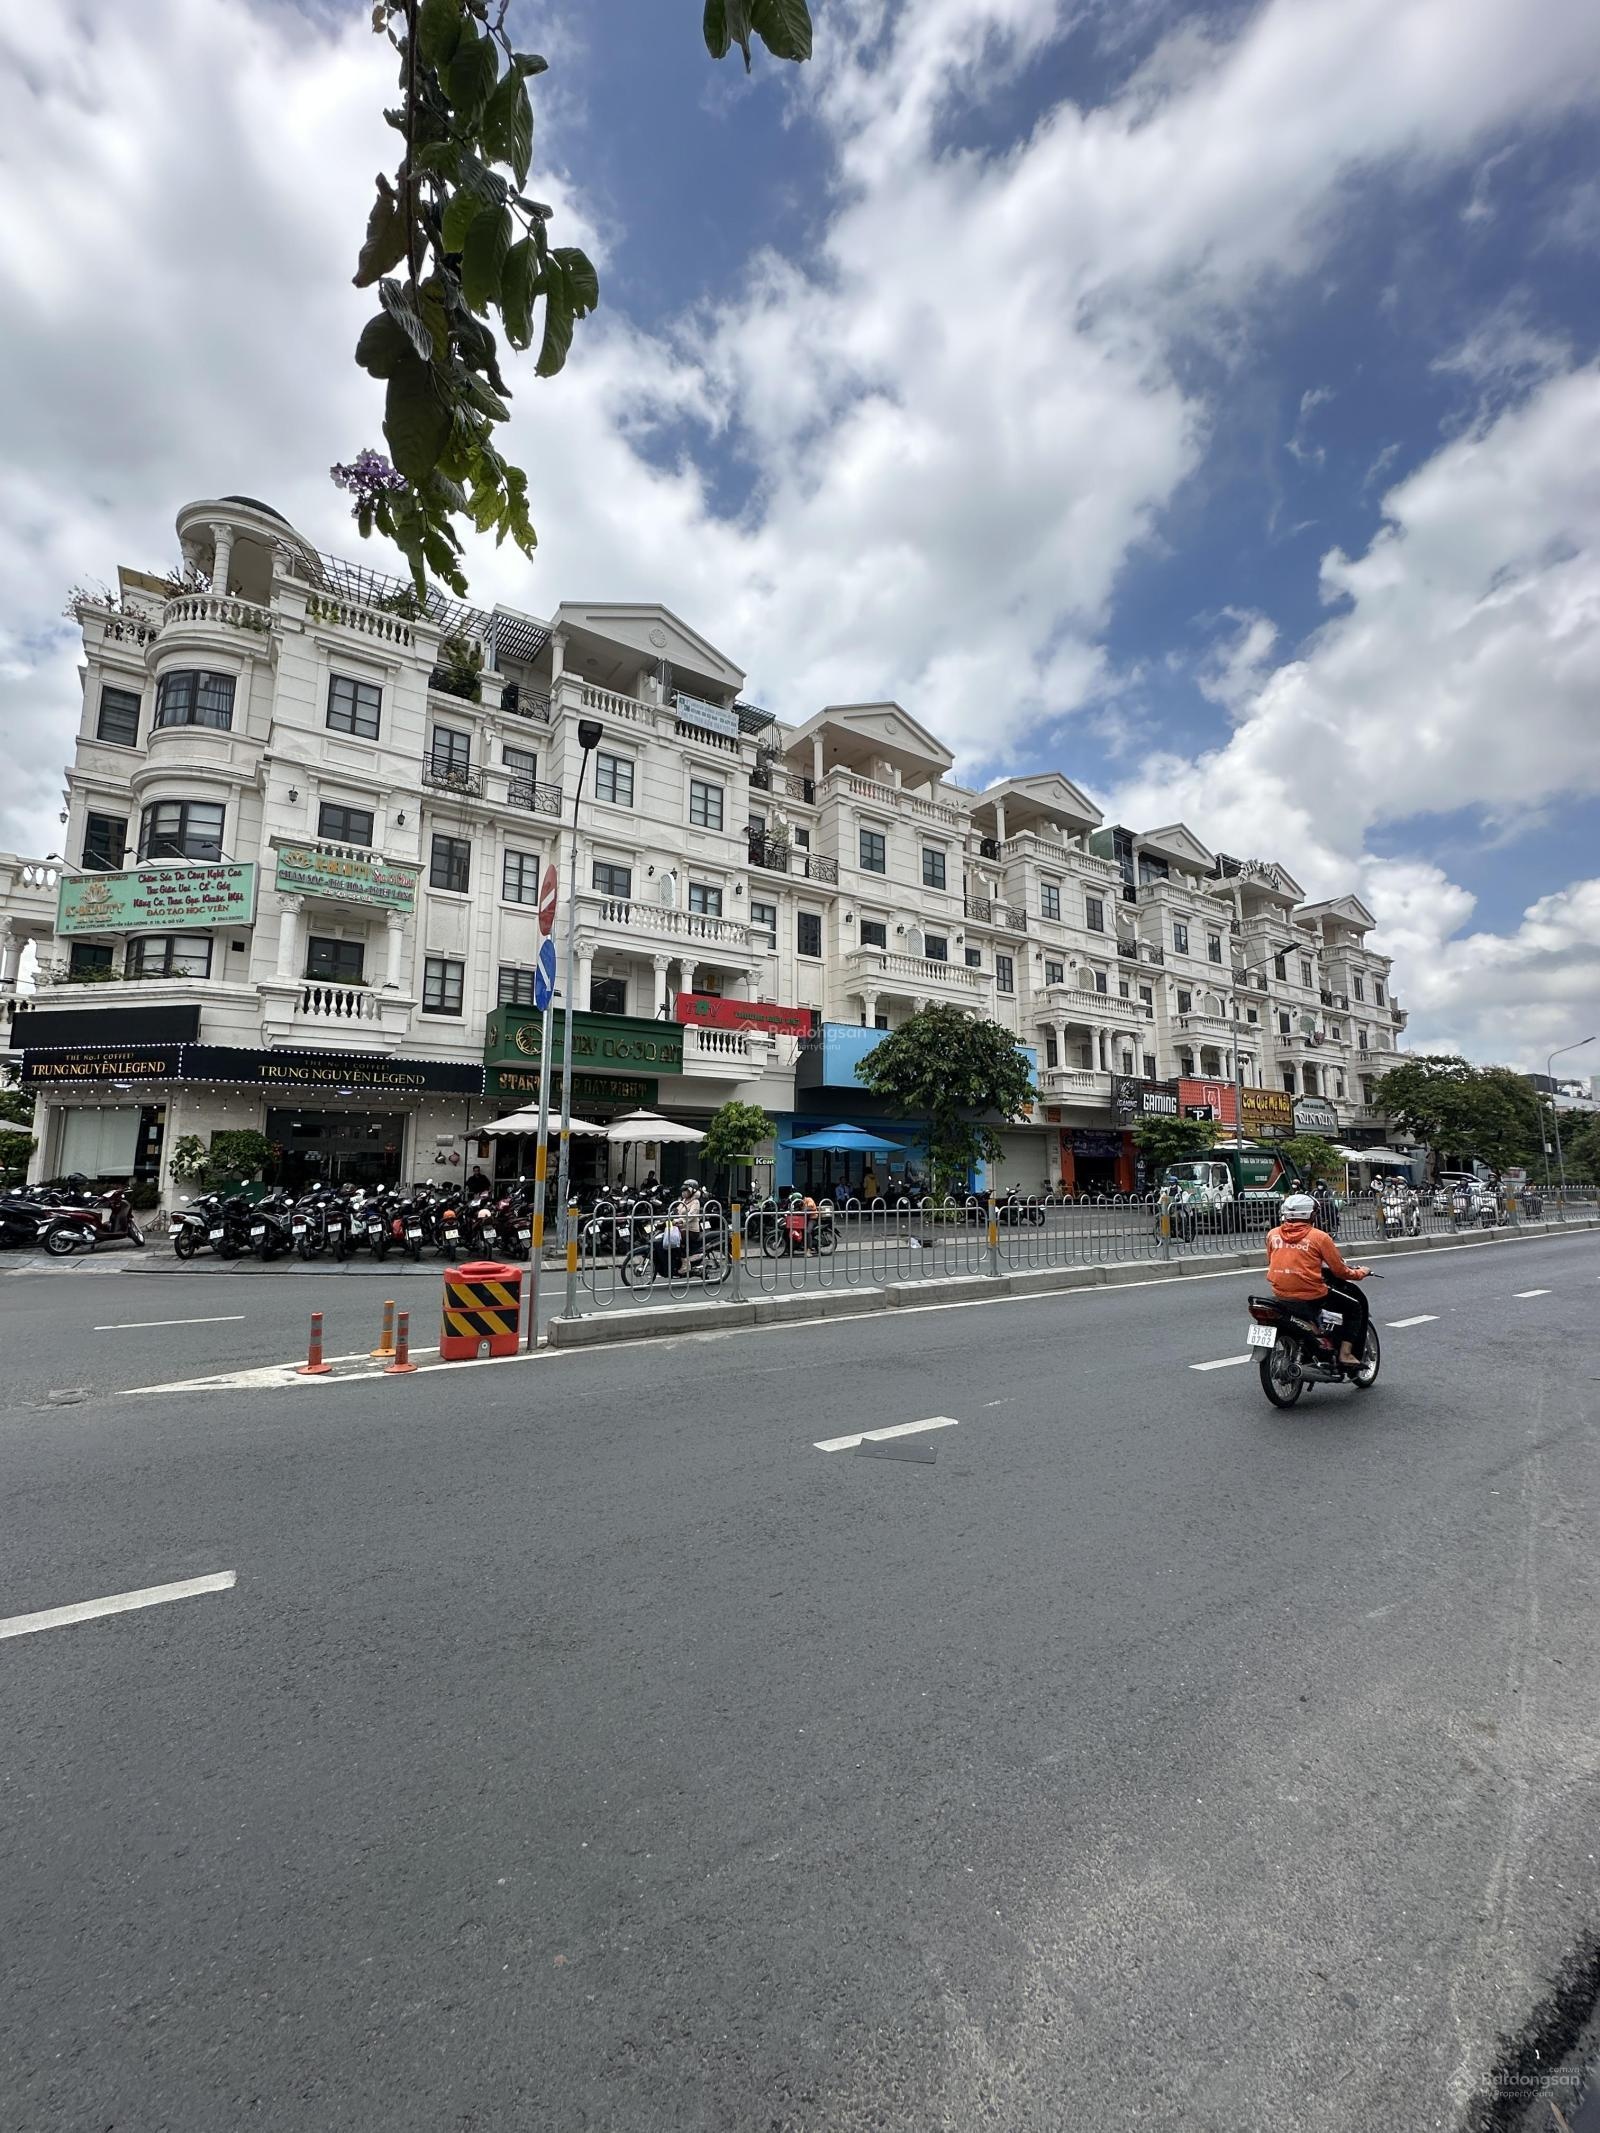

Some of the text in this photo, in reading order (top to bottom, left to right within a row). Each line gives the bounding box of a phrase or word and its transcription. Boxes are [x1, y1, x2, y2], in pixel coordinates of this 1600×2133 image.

[159, 872, 172, 881] Sóc
[174, 871, 186, 880] Da
[187, 870, 205, 880] Công
[228, 867, 242, 877] Cao
[64, 903, 125, 917] K-BEAUTY
[186, 906, 205, 915] HỌC
[602, 1037, 658, 1062] 06:30
[31, 1060, 166, 1076] TRUNG NGUYÊN LEGEND
[258, 1065, 426, 1085] TRUNG NGUYÊN LEGEND
[583, 1078, 611, 1096] DAY
[1143, 1093, 1177, 1114] GAMING
[1251, 1336, 1271, 1346] 0702
